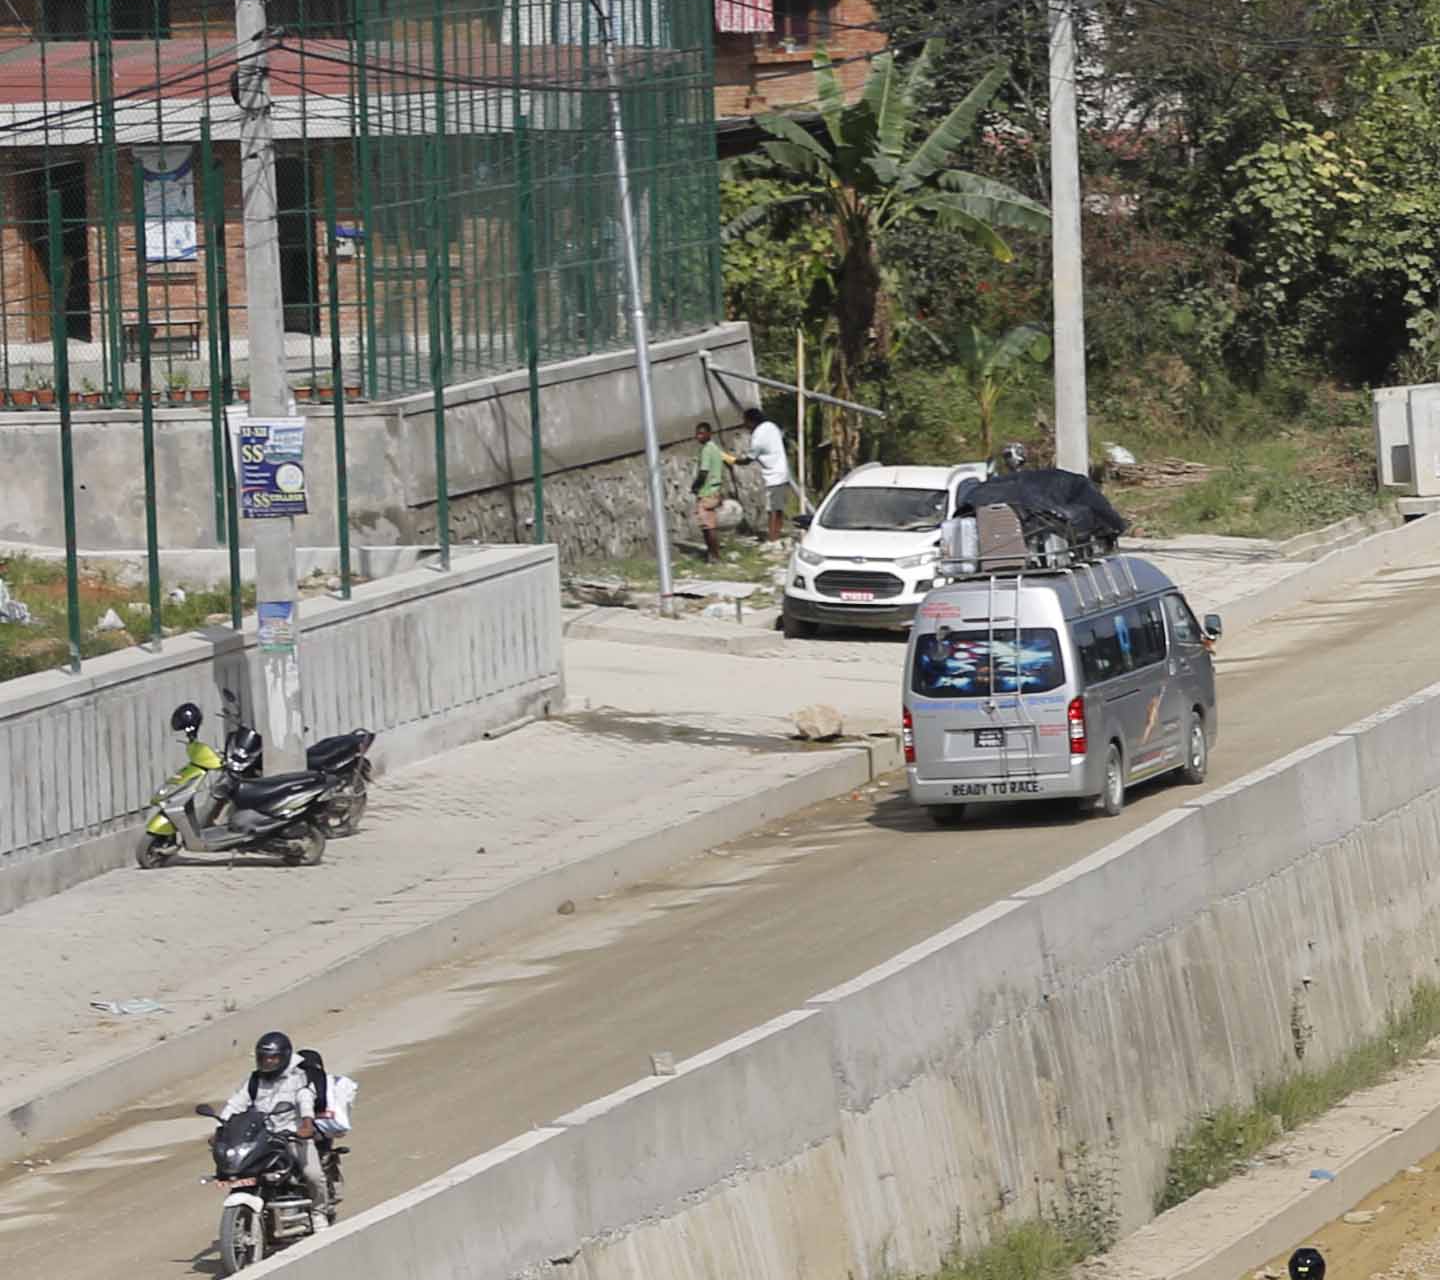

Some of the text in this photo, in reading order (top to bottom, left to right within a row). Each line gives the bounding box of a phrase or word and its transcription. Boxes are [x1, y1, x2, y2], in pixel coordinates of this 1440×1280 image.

[952, 781, 1039, 796] READY TO RACE
